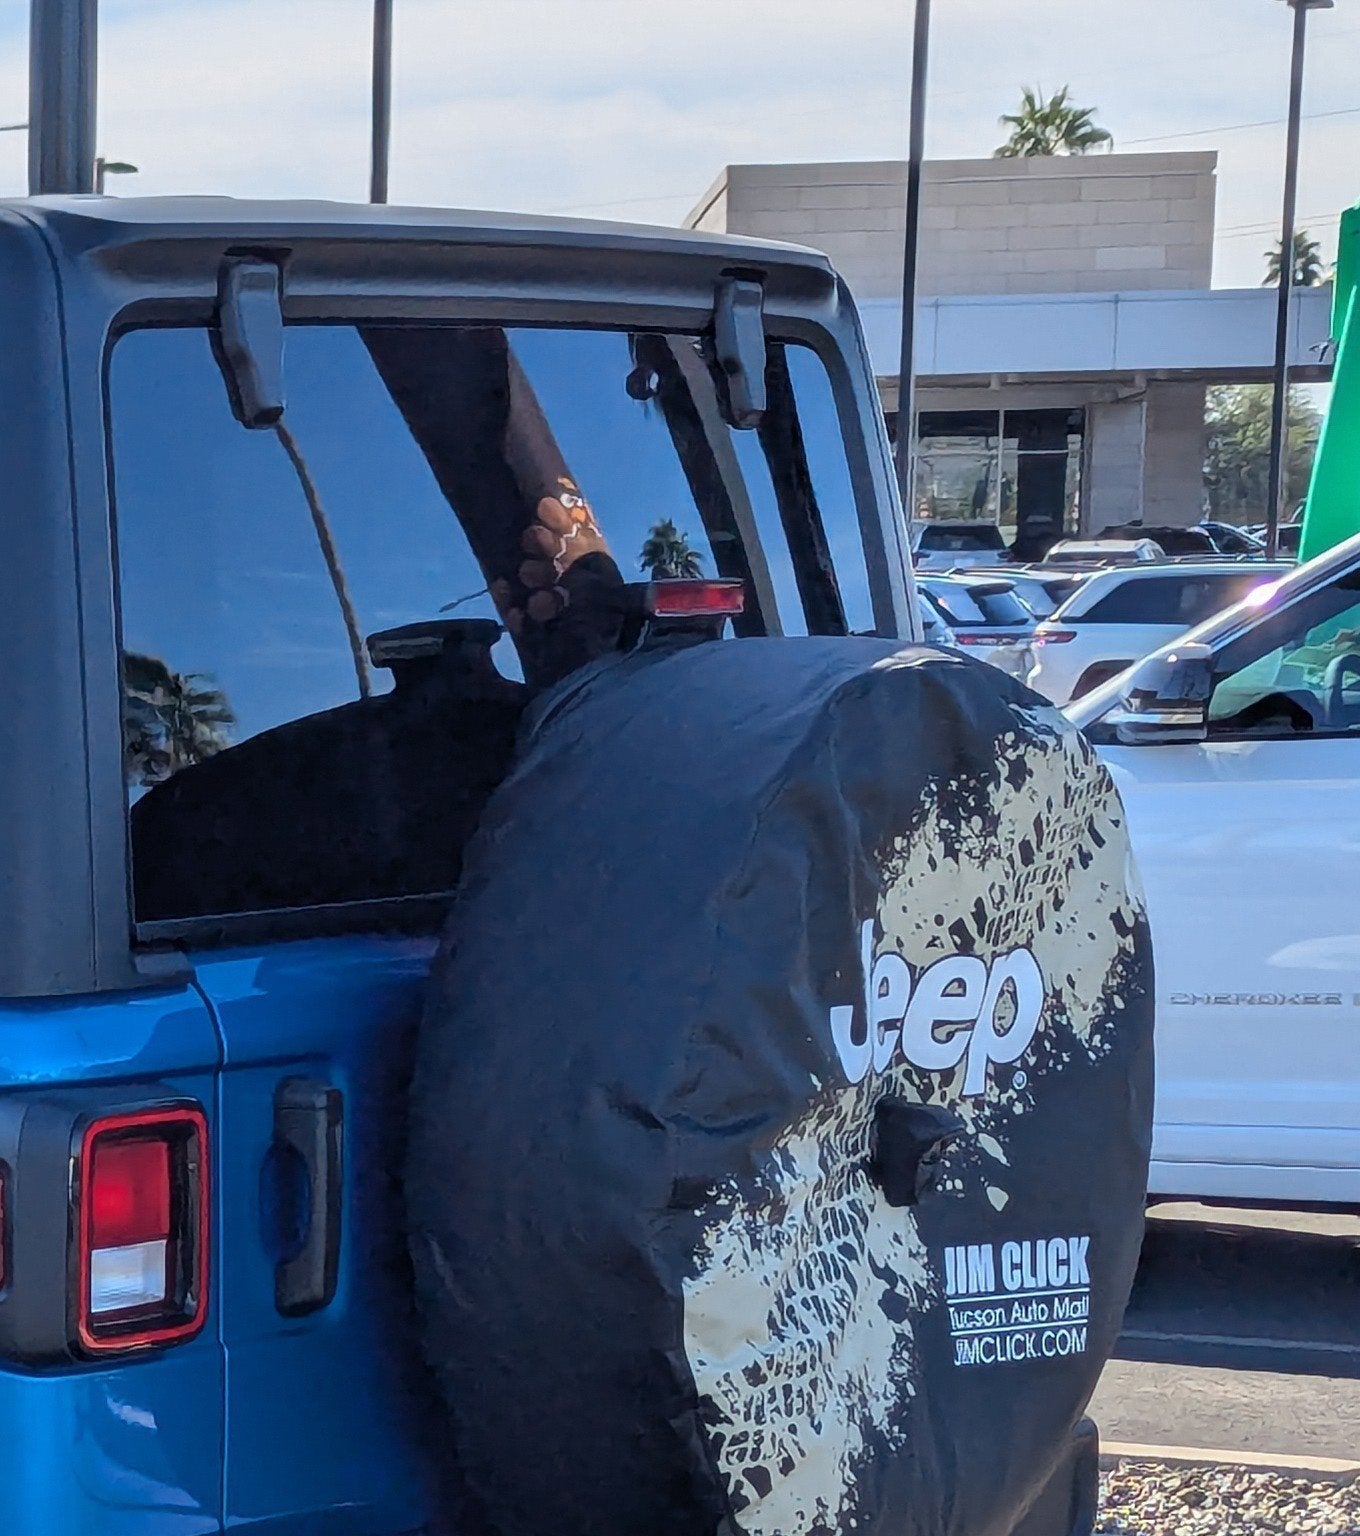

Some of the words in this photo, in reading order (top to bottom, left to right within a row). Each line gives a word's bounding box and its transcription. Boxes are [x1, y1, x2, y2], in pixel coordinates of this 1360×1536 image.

[829, 918, 1045, 1096] Jeep
[1169, 993, 1343, 1006] CHEROKEE
[944, 1243, 996, 1295] JIM
[1001, 1236, 1091, 1291] CLICK
[949, 1306, 1007, 1330] Tucson
[1010, 1300, 1049, 1324] Auto
[1053, 1294, 1090, 1320] Mall
